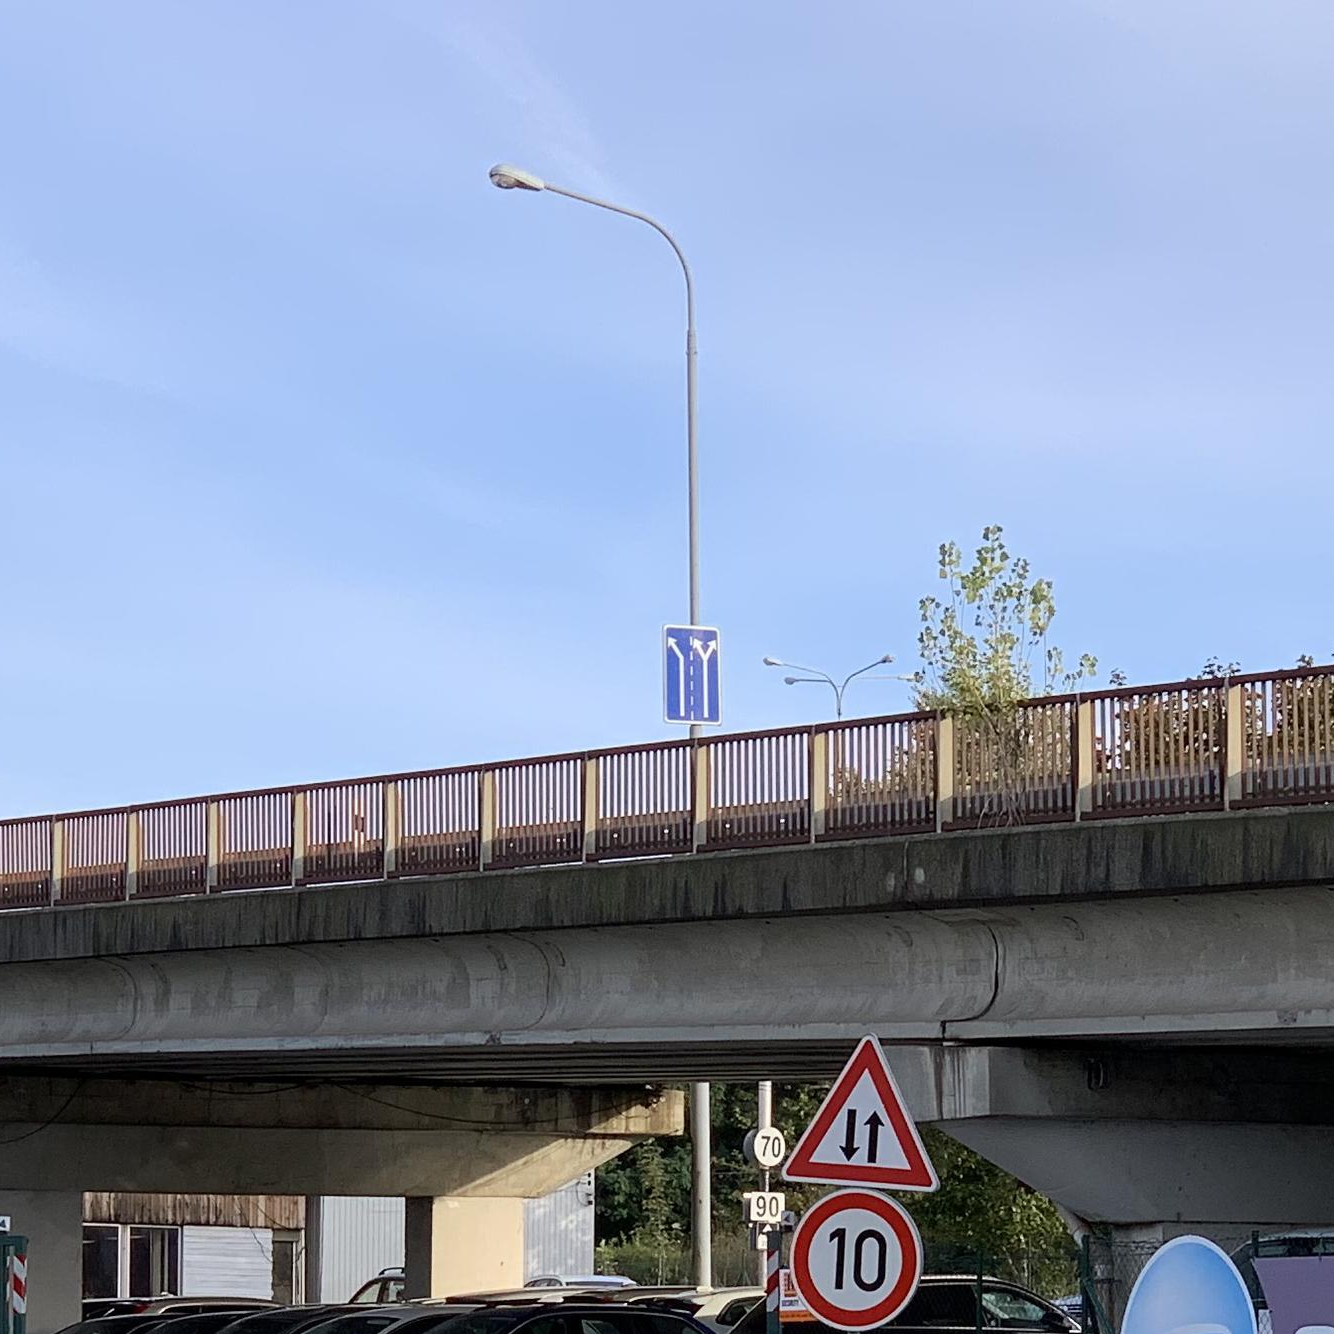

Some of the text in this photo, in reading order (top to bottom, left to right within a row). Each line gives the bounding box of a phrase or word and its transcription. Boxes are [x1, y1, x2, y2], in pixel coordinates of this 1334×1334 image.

[761, 1135, 781, 1158] 70
[756, 1195, 779, 1217] 90
[828, 1227, 888, 1292] 10
